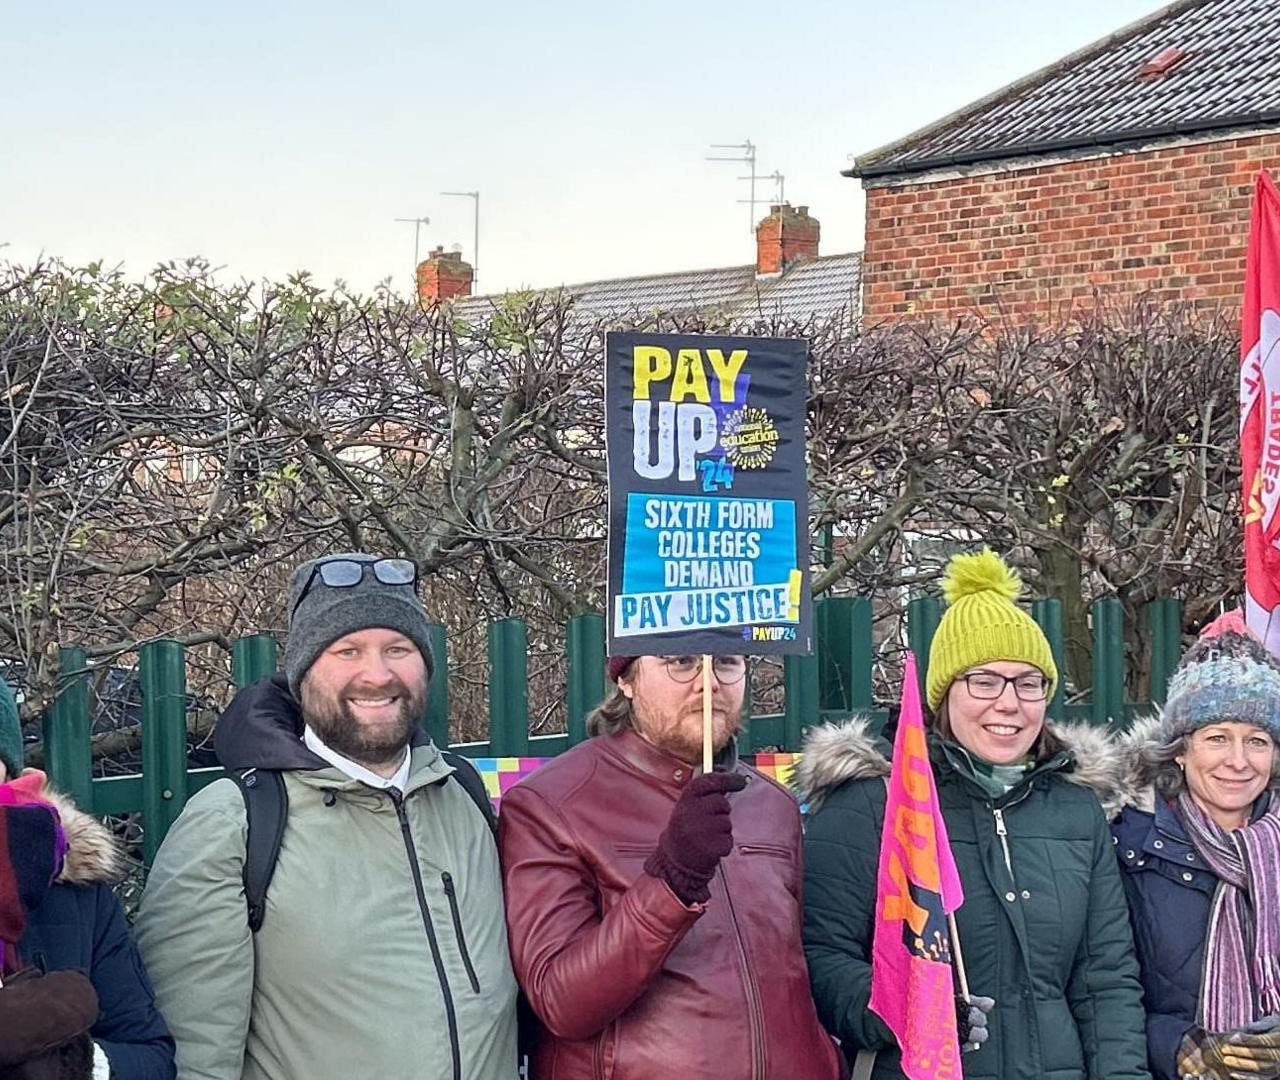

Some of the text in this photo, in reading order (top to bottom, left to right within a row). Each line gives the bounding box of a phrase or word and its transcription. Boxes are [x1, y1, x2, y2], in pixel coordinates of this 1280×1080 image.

[633, 346, 748, 402] PAY
[632, 400, 718, 481] UP
[720, 430, 779, 448] education
[644, 500, 773, 529] SIXTH FORM
[658, 531, 761, 559] COLLEGES
[664, 560, 754, 588] DEMAND
[622, 569, 802, 629] PAY JUSTICE!
